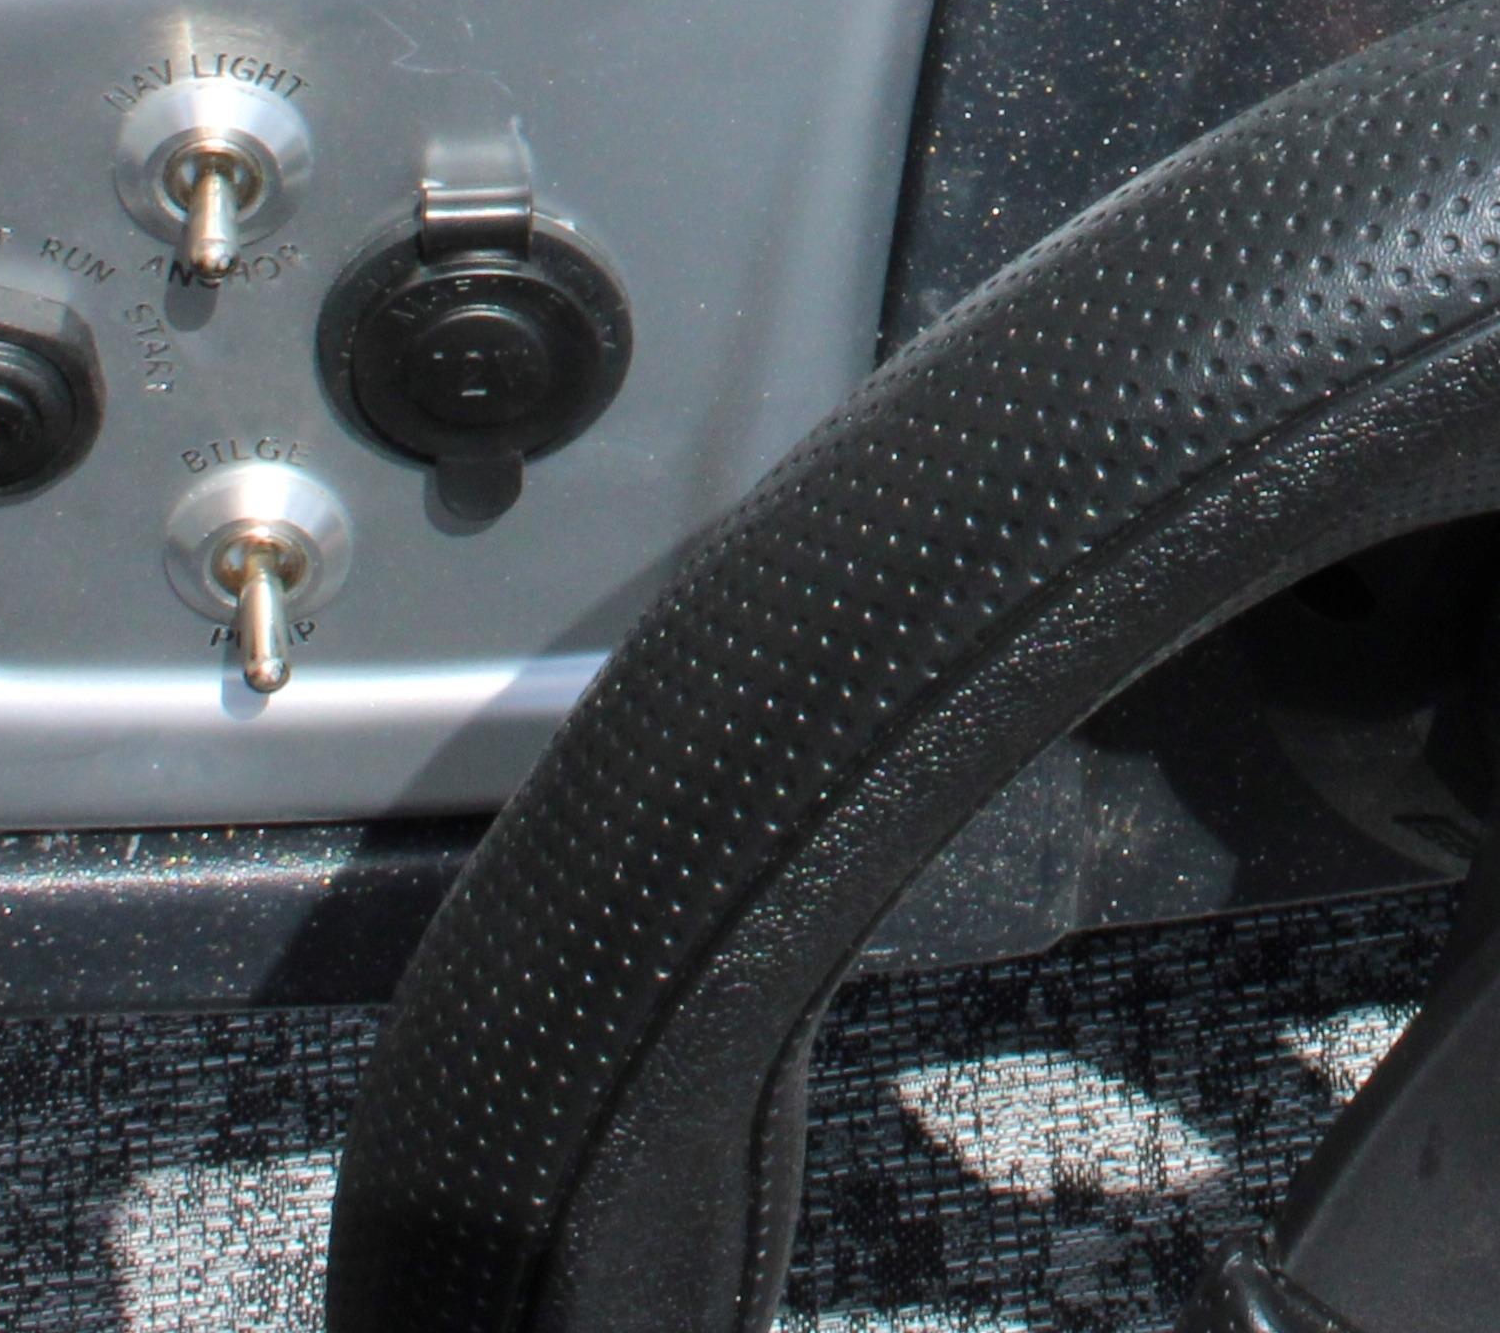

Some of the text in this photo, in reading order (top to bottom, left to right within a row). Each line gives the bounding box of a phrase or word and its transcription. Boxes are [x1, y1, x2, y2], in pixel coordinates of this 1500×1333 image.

[103, 52, 310, 111] NAV LIGHT
[39, 235, 116, 284] RUN
[140, 244, 305, 289] ANHOR
[124, 302, 174, 393] START
[180, 437, 312, 474] BILGE
[210, 619, 316, 649] PP
